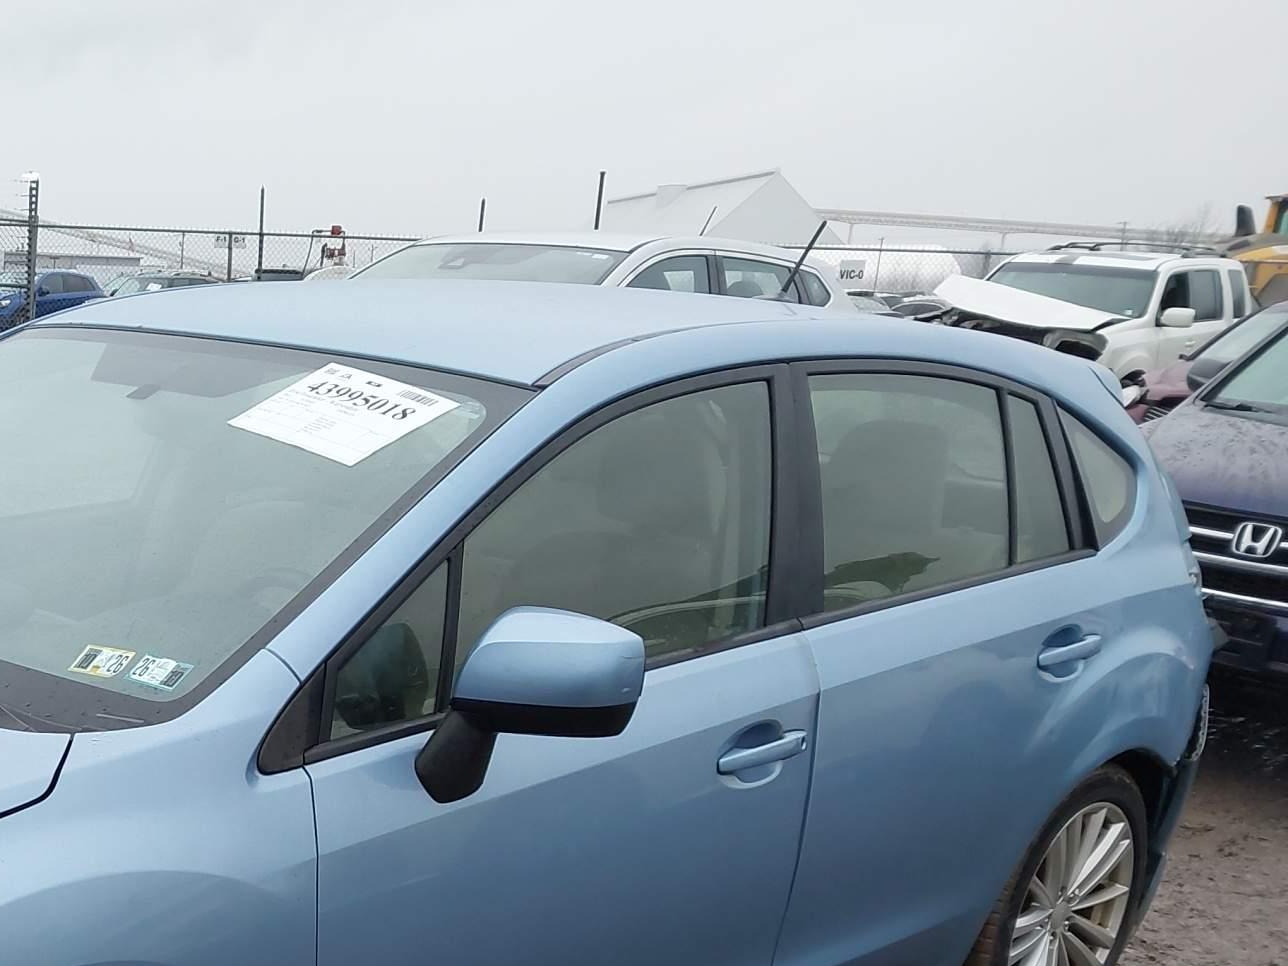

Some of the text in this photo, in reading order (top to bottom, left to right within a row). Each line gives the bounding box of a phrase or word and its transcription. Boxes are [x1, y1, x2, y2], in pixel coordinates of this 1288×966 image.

[307, 380, 417, 421] 43995018
[106, 654, 130, 674] 26
[131, 657, 156, 677] 26
